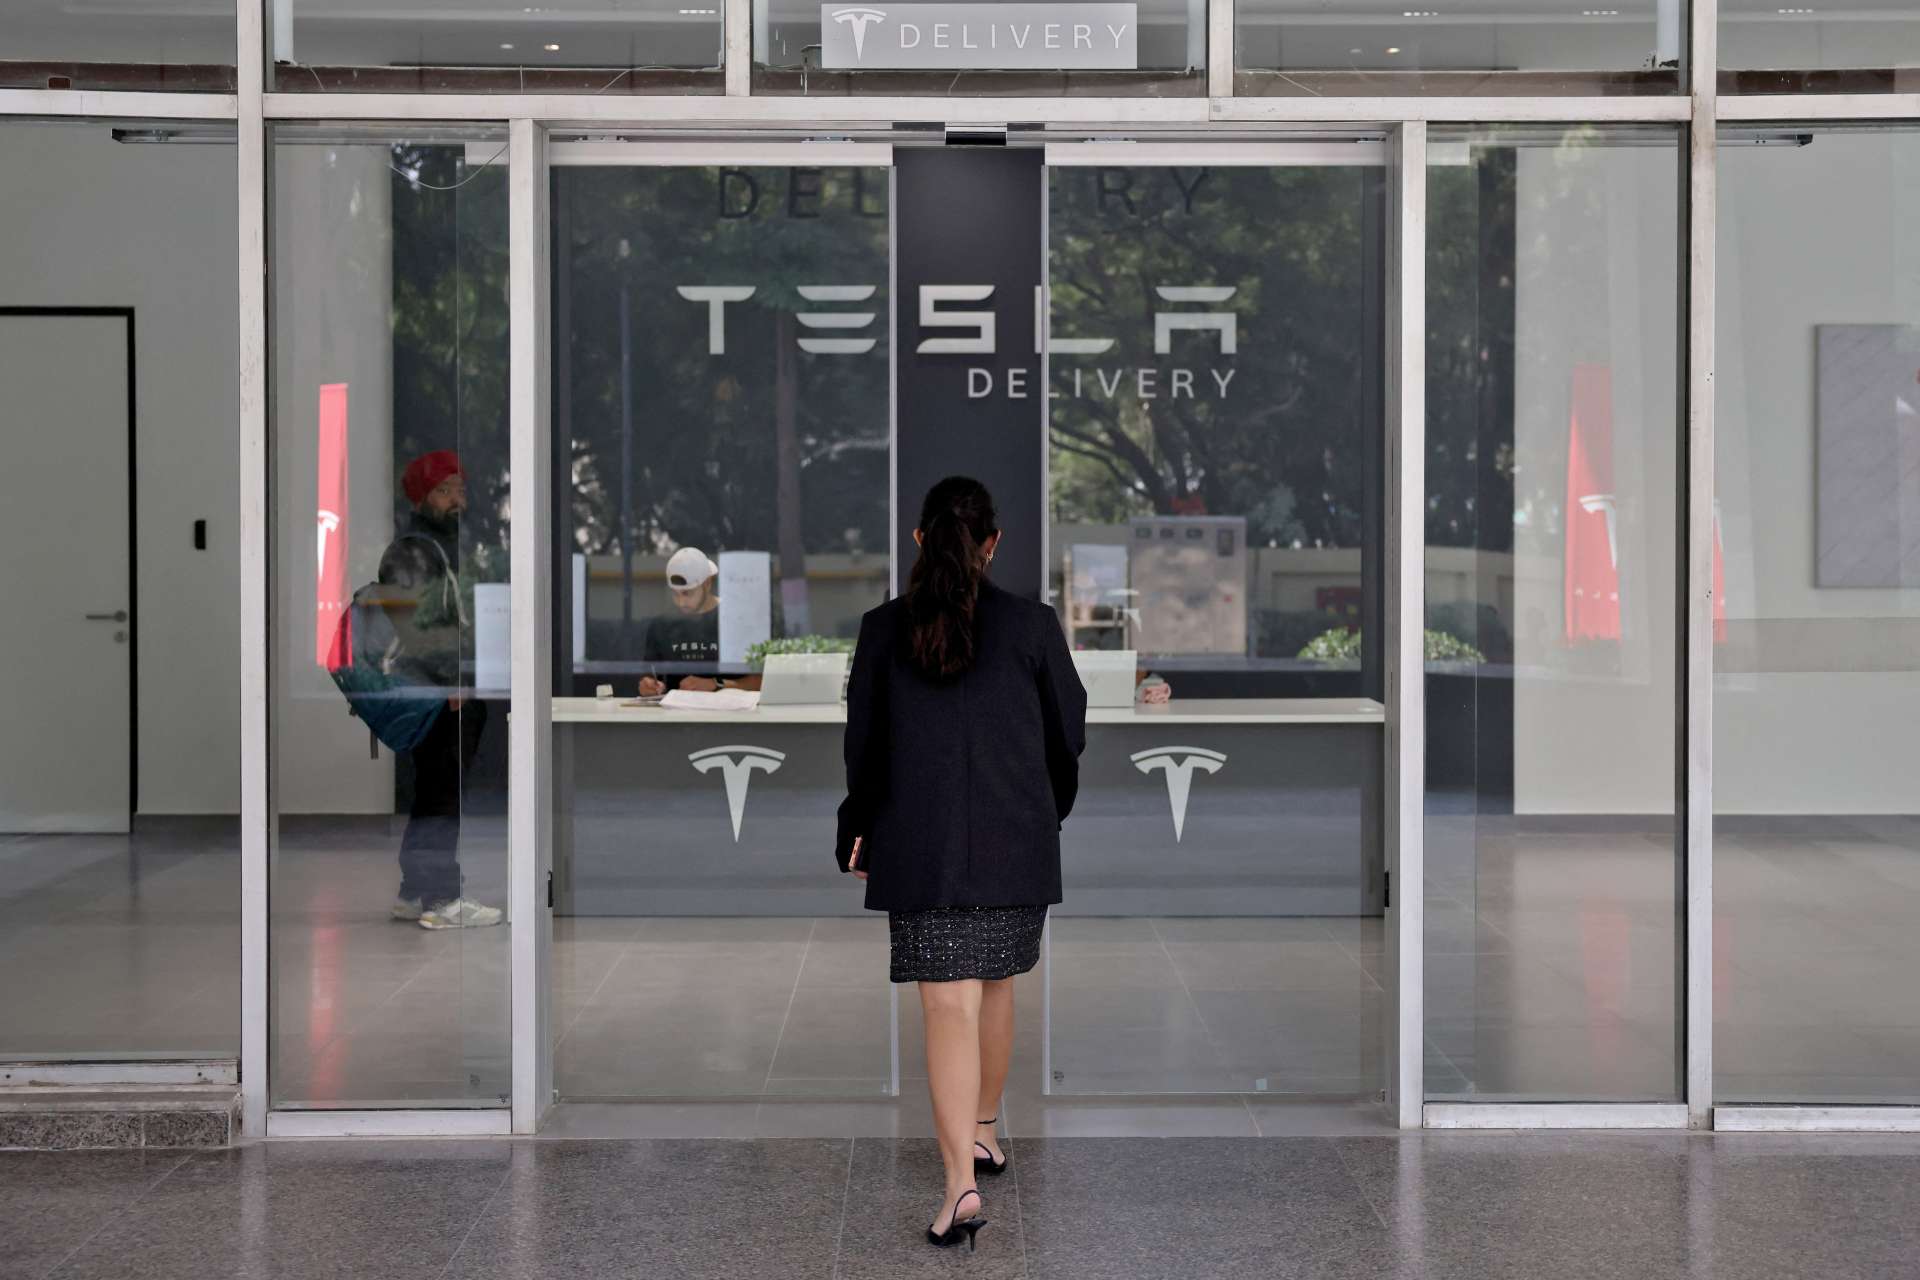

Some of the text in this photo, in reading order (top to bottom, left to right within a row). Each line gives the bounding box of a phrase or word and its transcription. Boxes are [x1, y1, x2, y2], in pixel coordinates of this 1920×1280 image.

[900, 24, 1127, 49] DELIVERY
[720, 166, 1208, 219] DELRY
[677, 285, 1237, 355] TESLA
[672, 642, 718, 652] TESLA
